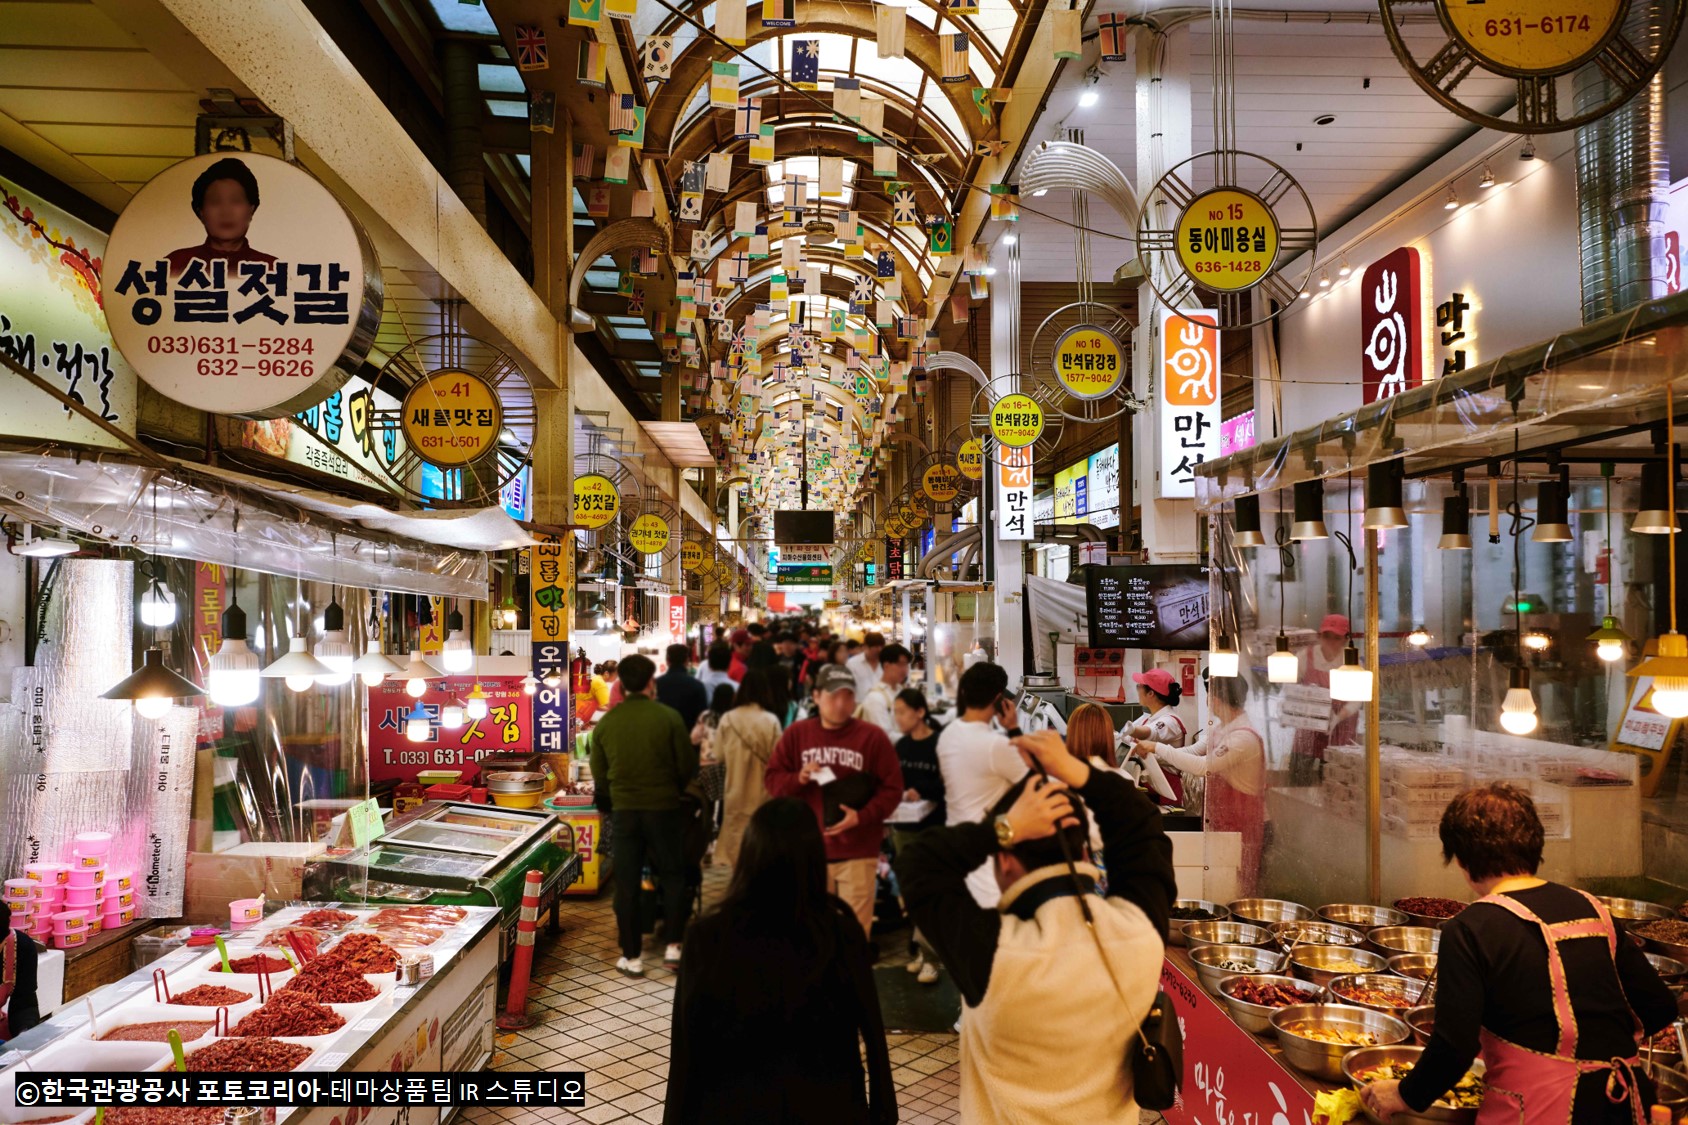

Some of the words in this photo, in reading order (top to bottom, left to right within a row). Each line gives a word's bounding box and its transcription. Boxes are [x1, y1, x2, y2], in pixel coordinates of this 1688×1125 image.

[607, 11, 632, 19] WELCOME
[1485, 14, 1591, 37] 631-6174
[1208, 210, 1224, 221] NO
[1227, 203, 1243, 220] 15
[1189, 226, 1266, 254] 동아미용실
[1195, 261, 1262, 273] 636-1428
[115, 258, 350, 327] 성실젓갈
[147, 335, 315, 358] 033)631-5284
[1076, 340, 1087, 349] NO
[1090, 338, 1101, 348] 16
[197, 357, 314, 378] 632-9626
[1062, 353, 1116, 371] 만석닭강정
[1066, 373, 1112, 383] 1577-9042
[434, 390, 446, 398] NO
[450, 382, 470, 397] 41
[1013, 401, 1032, 409] 16-1
[411, 408, 493, 427] 새롬맛집
[995, 413, 1039, 426] 만석닭강정
[421, 436, 481, 448] 631-0501
[998, 429, 1035, 437] 1577-9042
[592, 482, 602, 491] 42
[1005, 490, 1028, 535] 만석
[654, 529, 668, 540] 젓갈
[535, 537, 565, 637] 새롬맛집
[1179, 601, 1200, 625] 만석
[200, 561, 222, 710] 새롬맛
[383, 748, 397, 765] T.
[400, 751, 429, 765] 033)
[801, 746, 864, 771] STANFORD
